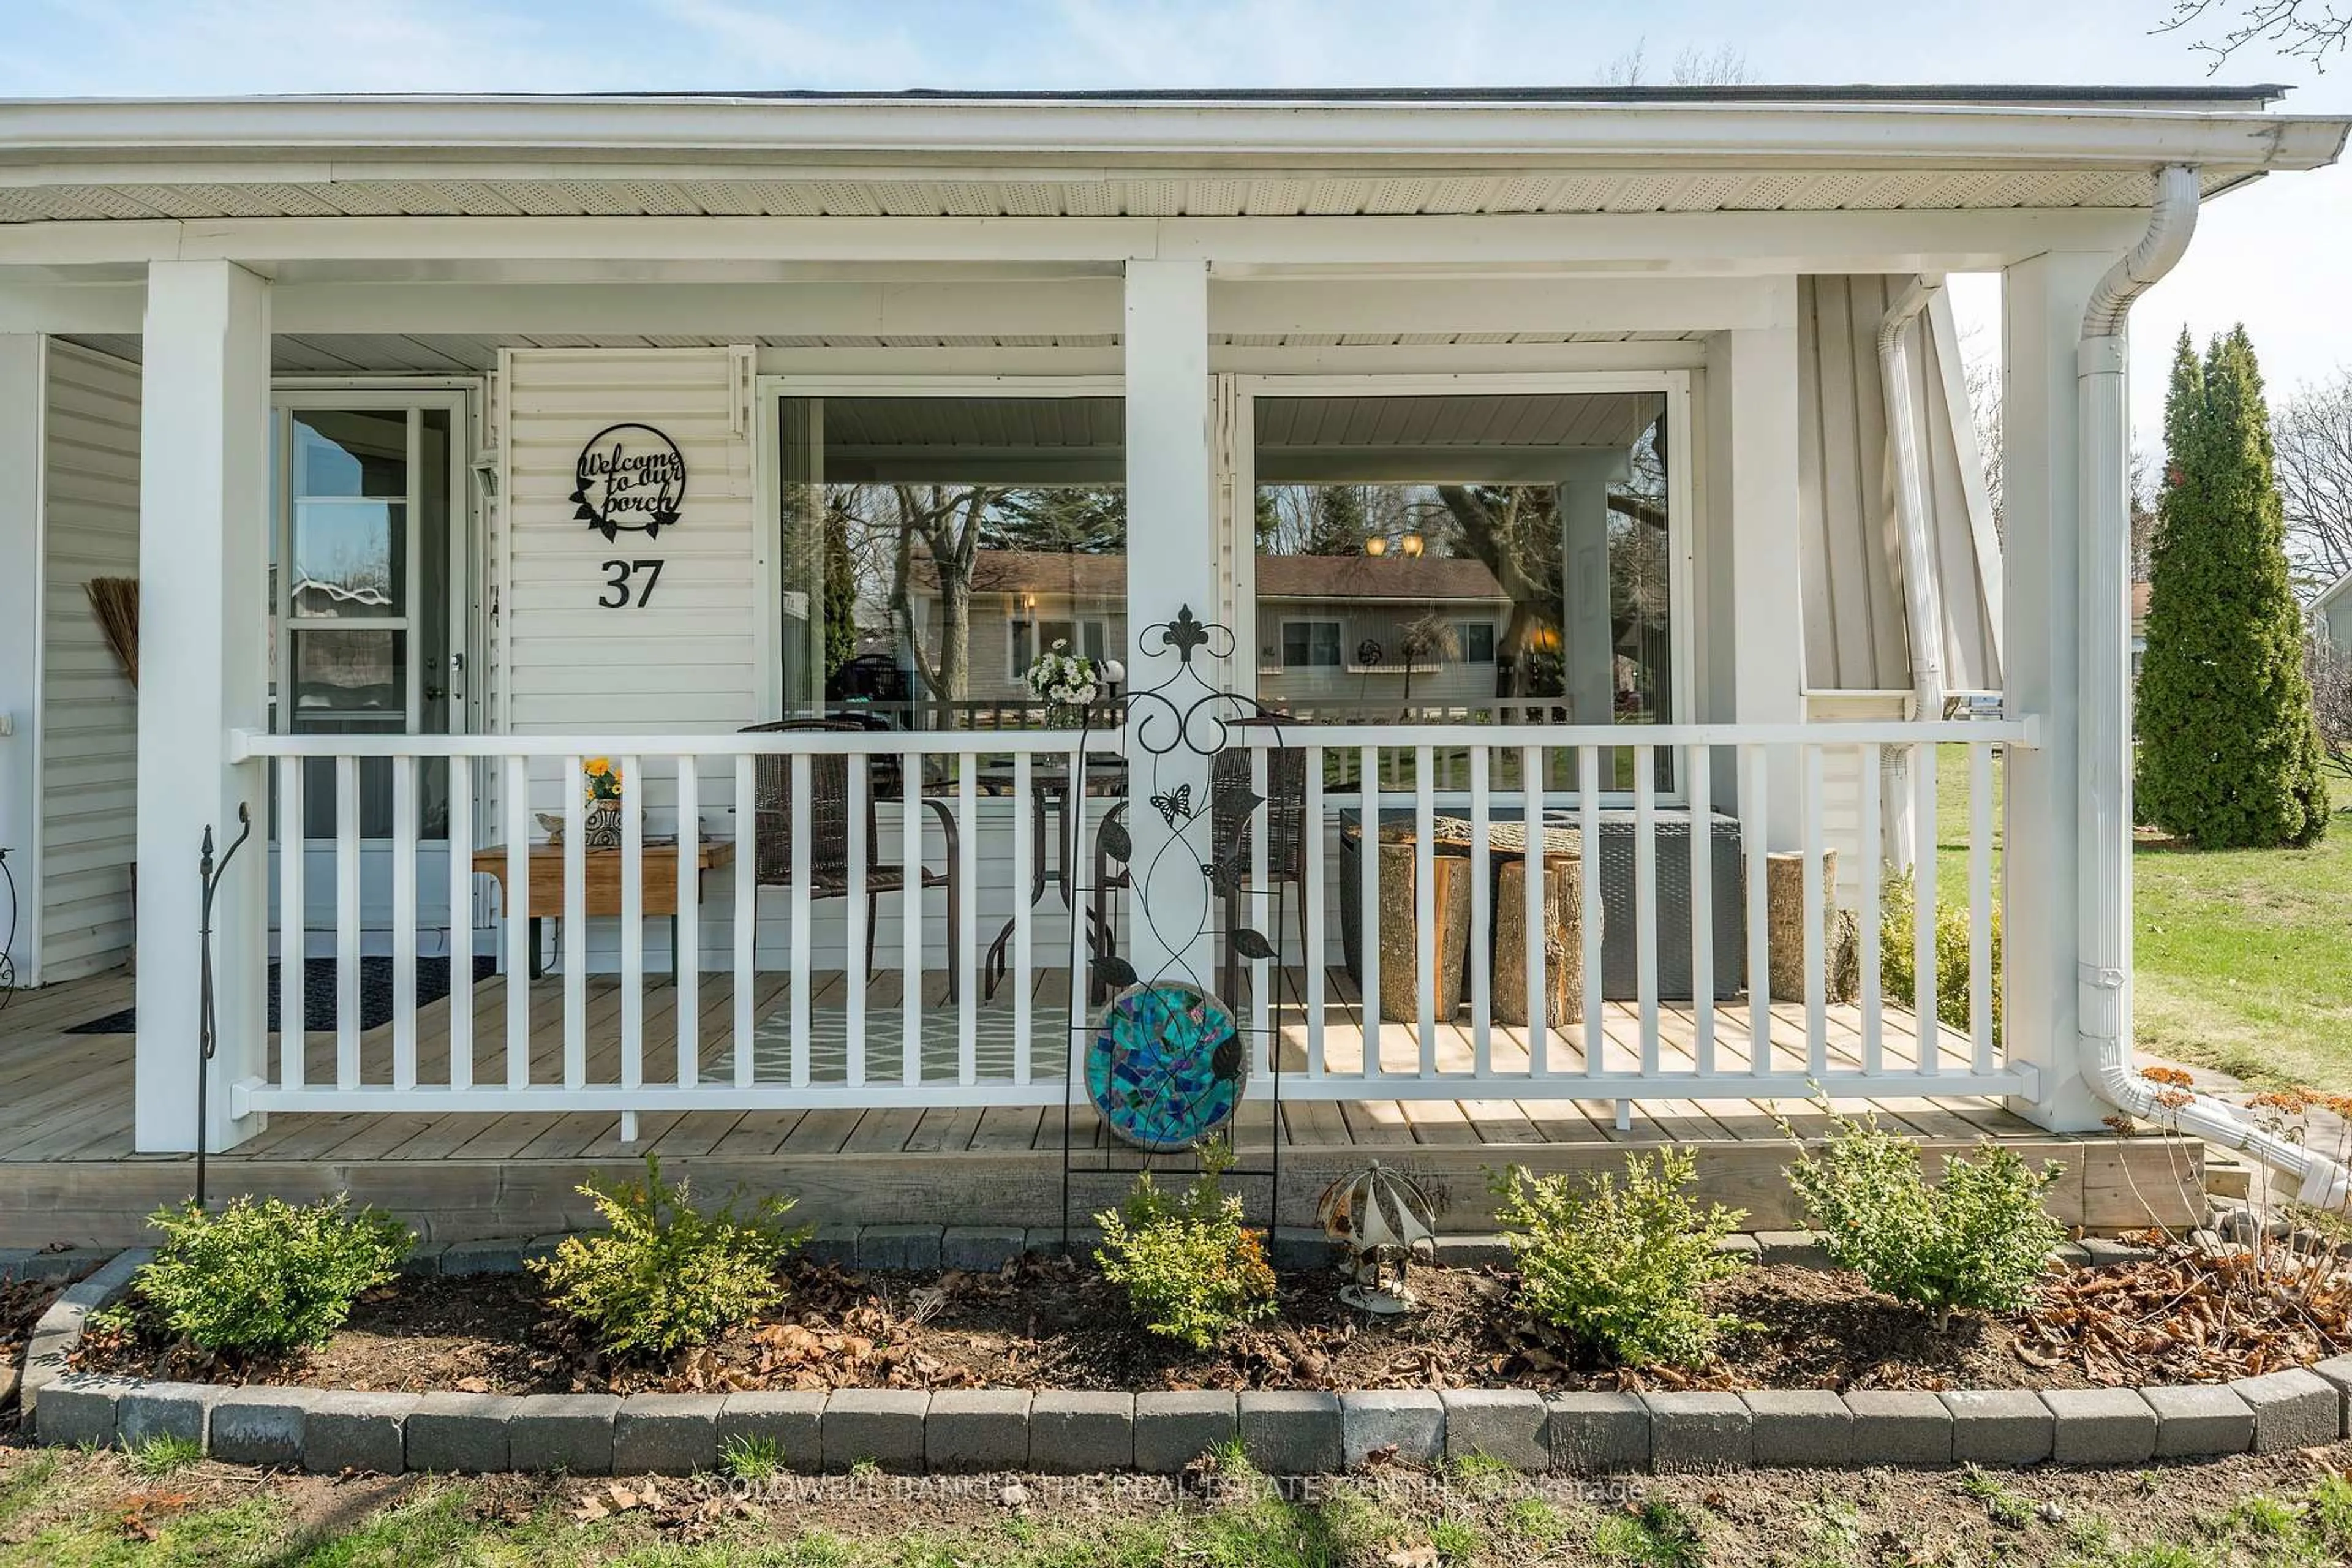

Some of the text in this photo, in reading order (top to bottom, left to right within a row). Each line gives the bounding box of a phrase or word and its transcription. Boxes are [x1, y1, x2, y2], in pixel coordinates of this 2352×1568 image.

[581, 443, 679, 476] Welcome
[605, 467, 682, 494] to our
[601, 481, 674, 521] porch
[598, 559, 664, 608] 37
